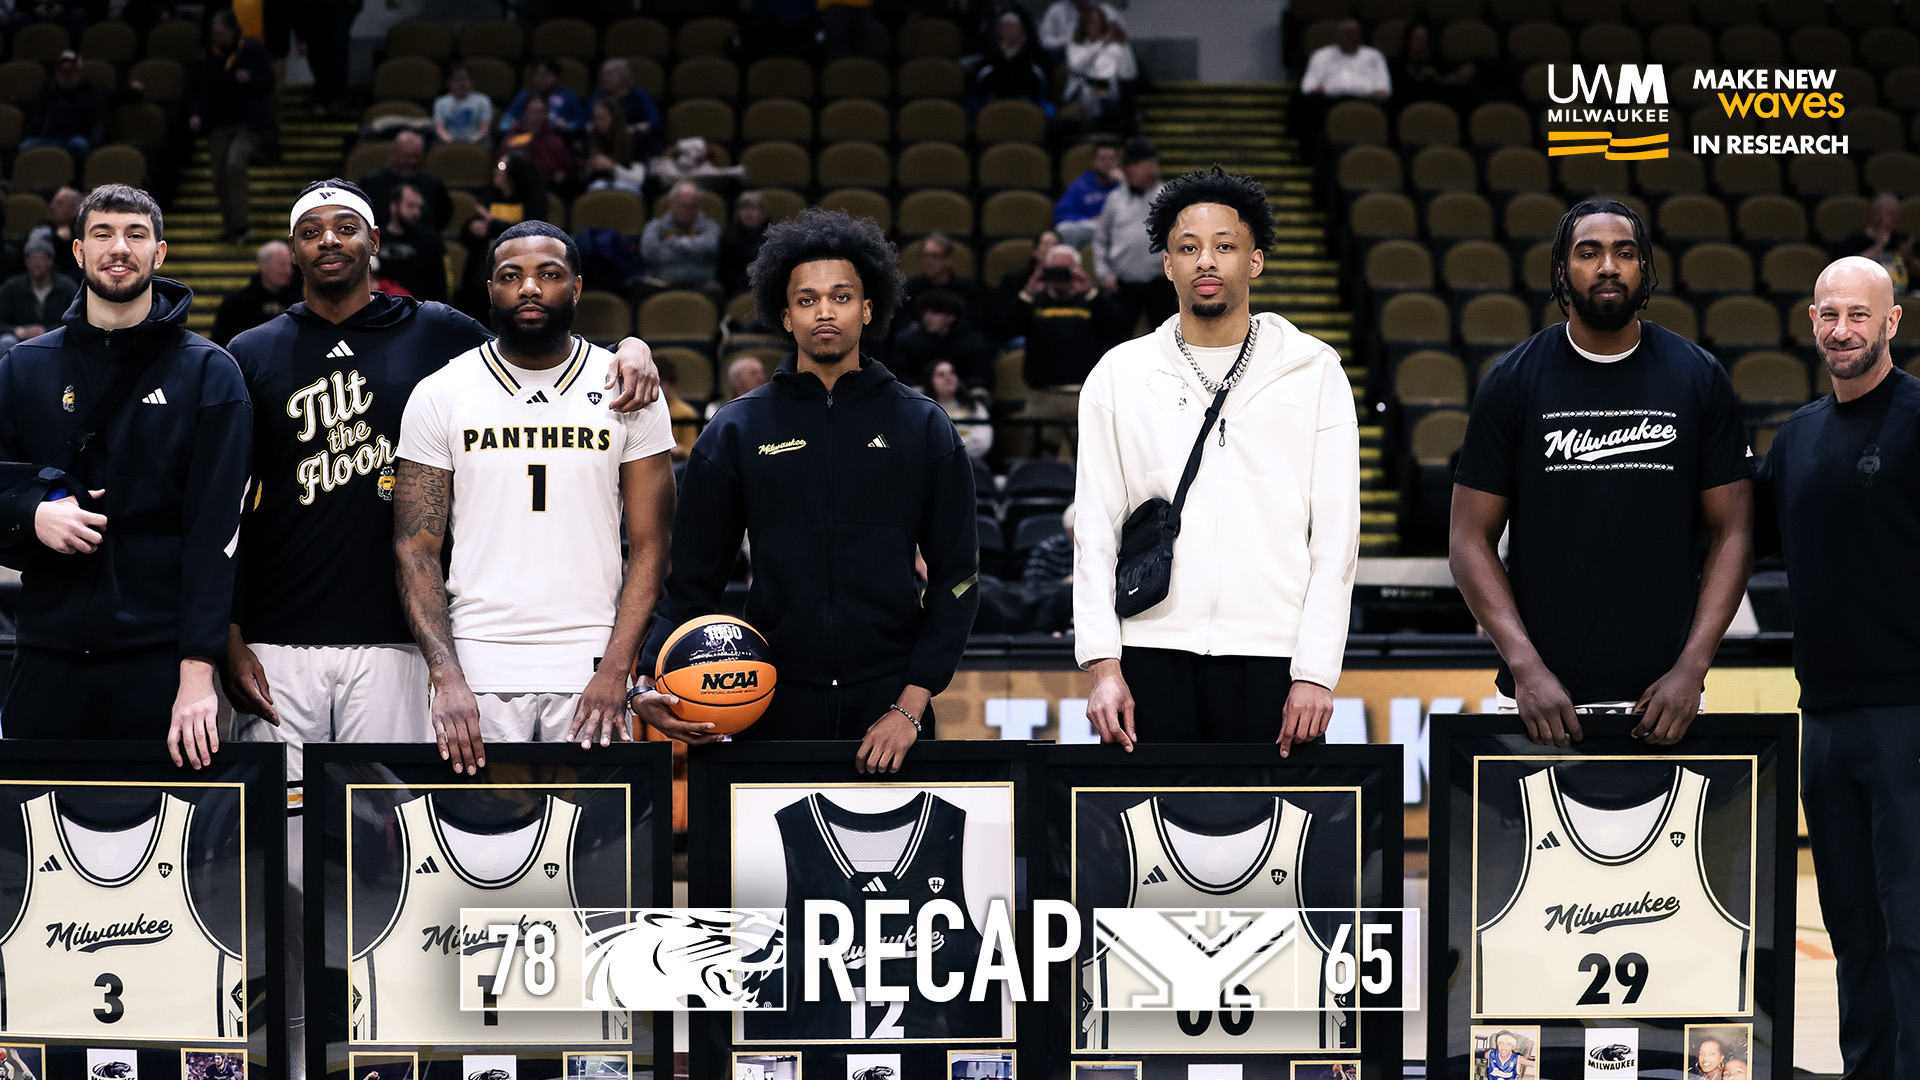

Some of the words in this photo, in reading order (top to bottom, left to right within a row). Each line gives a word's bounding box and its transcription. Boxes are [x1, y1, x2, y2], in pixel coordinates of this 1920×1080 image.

[286, 369, 374, 442] Tilt
[327, 420, 372, 454] the
[462, 426, 612, 453] PANTHERS
[758, 438, 807, 456] Milwaukee
[1544, 416, 1677, 462] Milwaukee
[296, 434, 397, 506] Floor
[526, 463, 548, 513] 1
[701, 669, 759, 691] NCAA
[46, 912, 174, 954] Milwaukee
[1543, 891, 1681, 935] Milwaukee
[92, 971, 125, 1025] 3
[1575, 951, 1650, 1006] 29
[1587, 1058, 1636, 1071] MILWAUKEE
